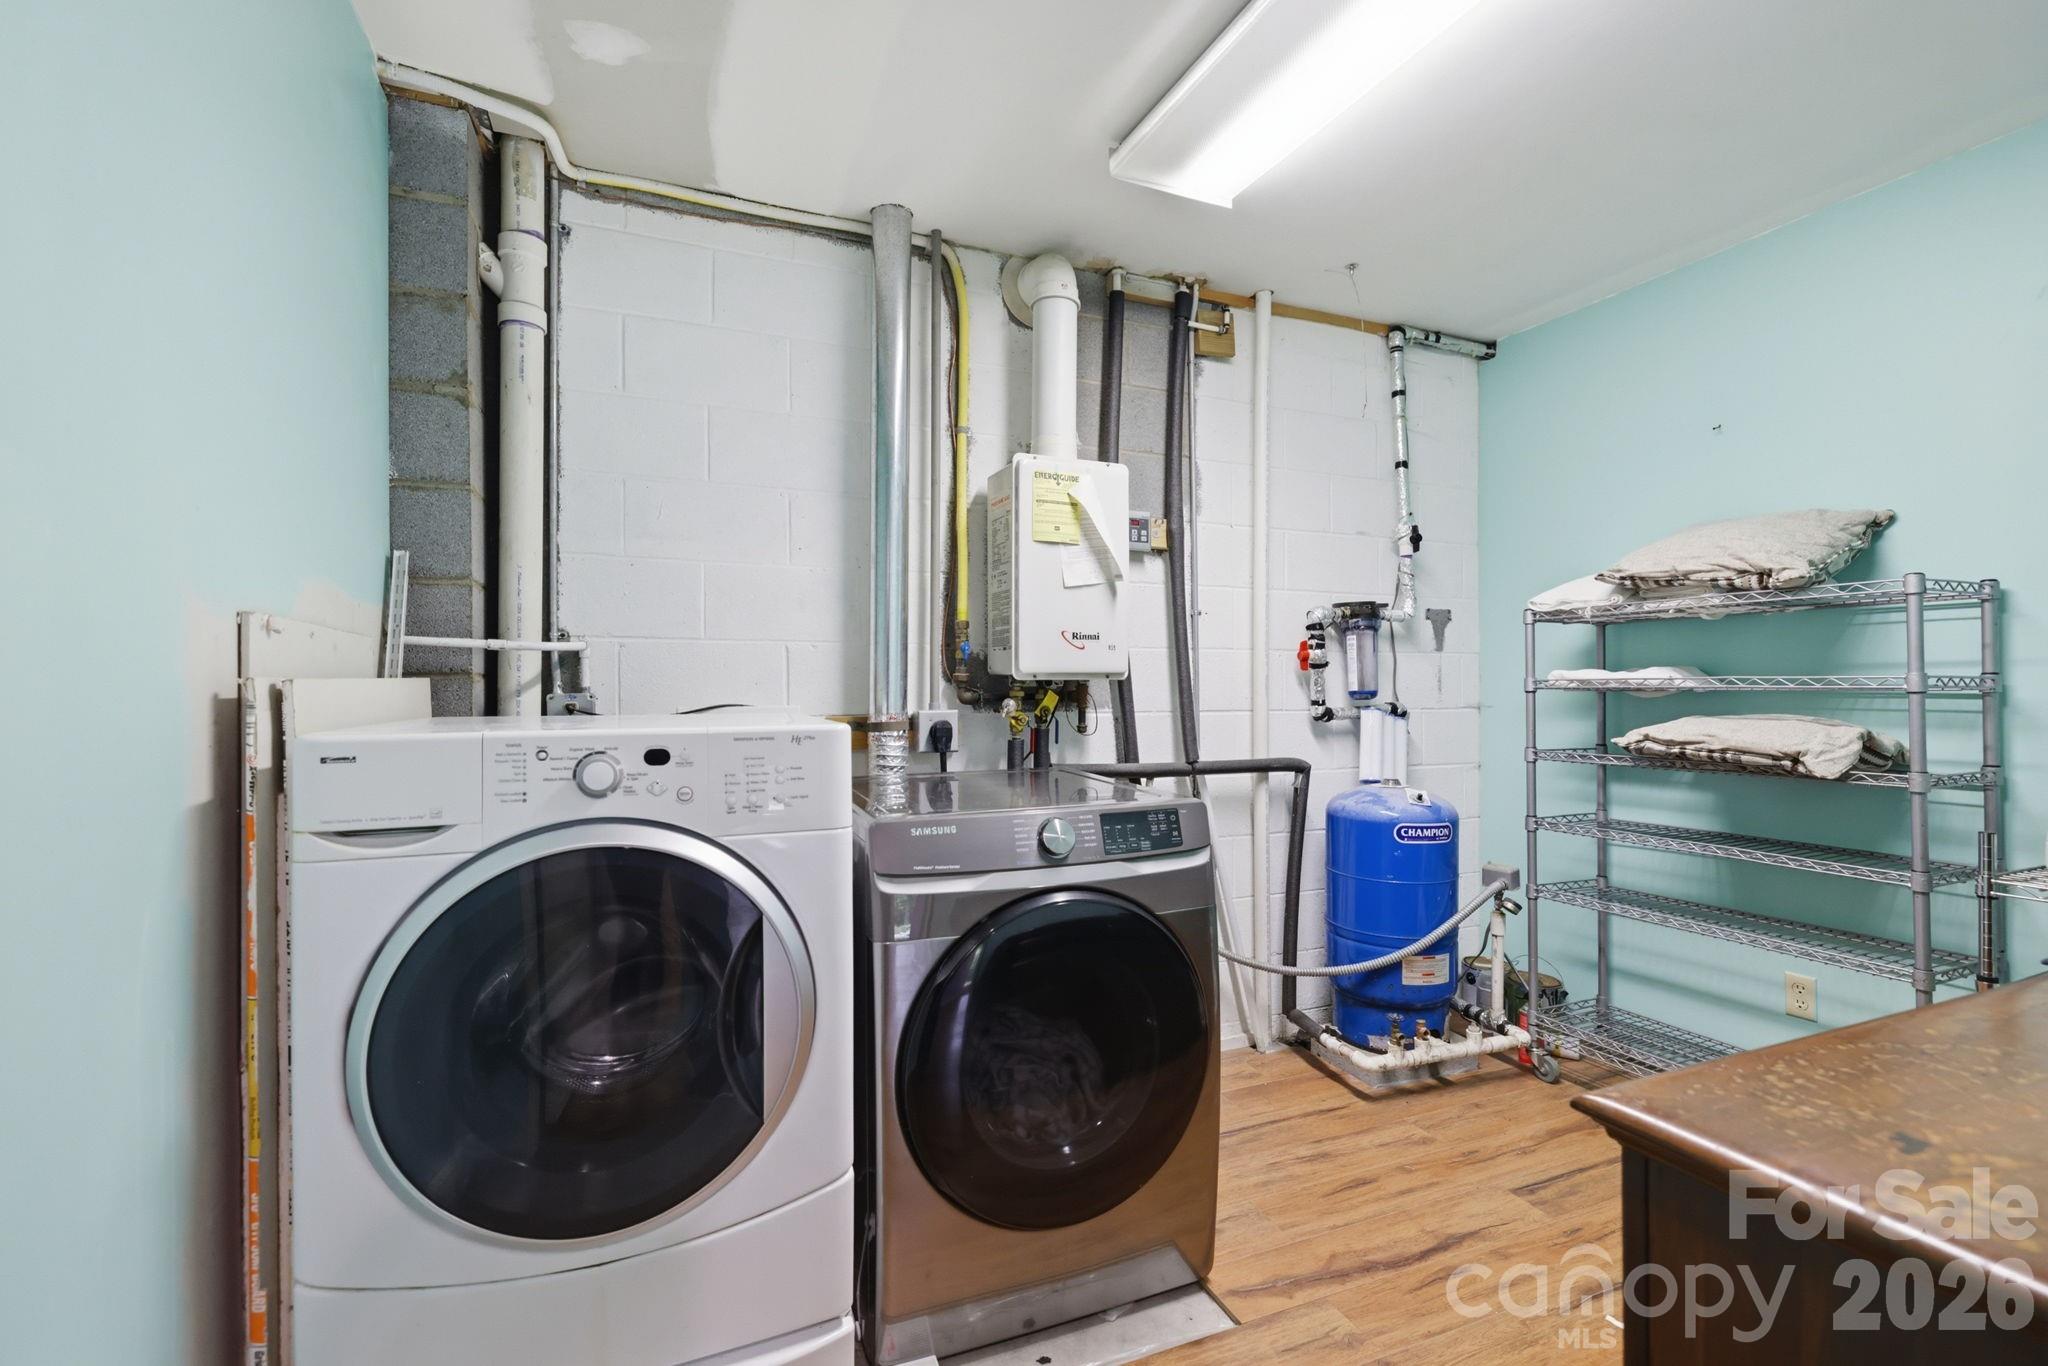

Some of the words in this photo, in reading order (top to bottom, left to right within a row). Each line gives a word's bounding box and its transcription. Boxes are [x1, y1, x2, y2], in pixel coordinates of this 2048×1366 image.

[1071, 631, 1100, 641] Rinnai
[910, 825, 957, 836] SAMSUNG
[1401, 828, 1449, 837] CHAMPION
